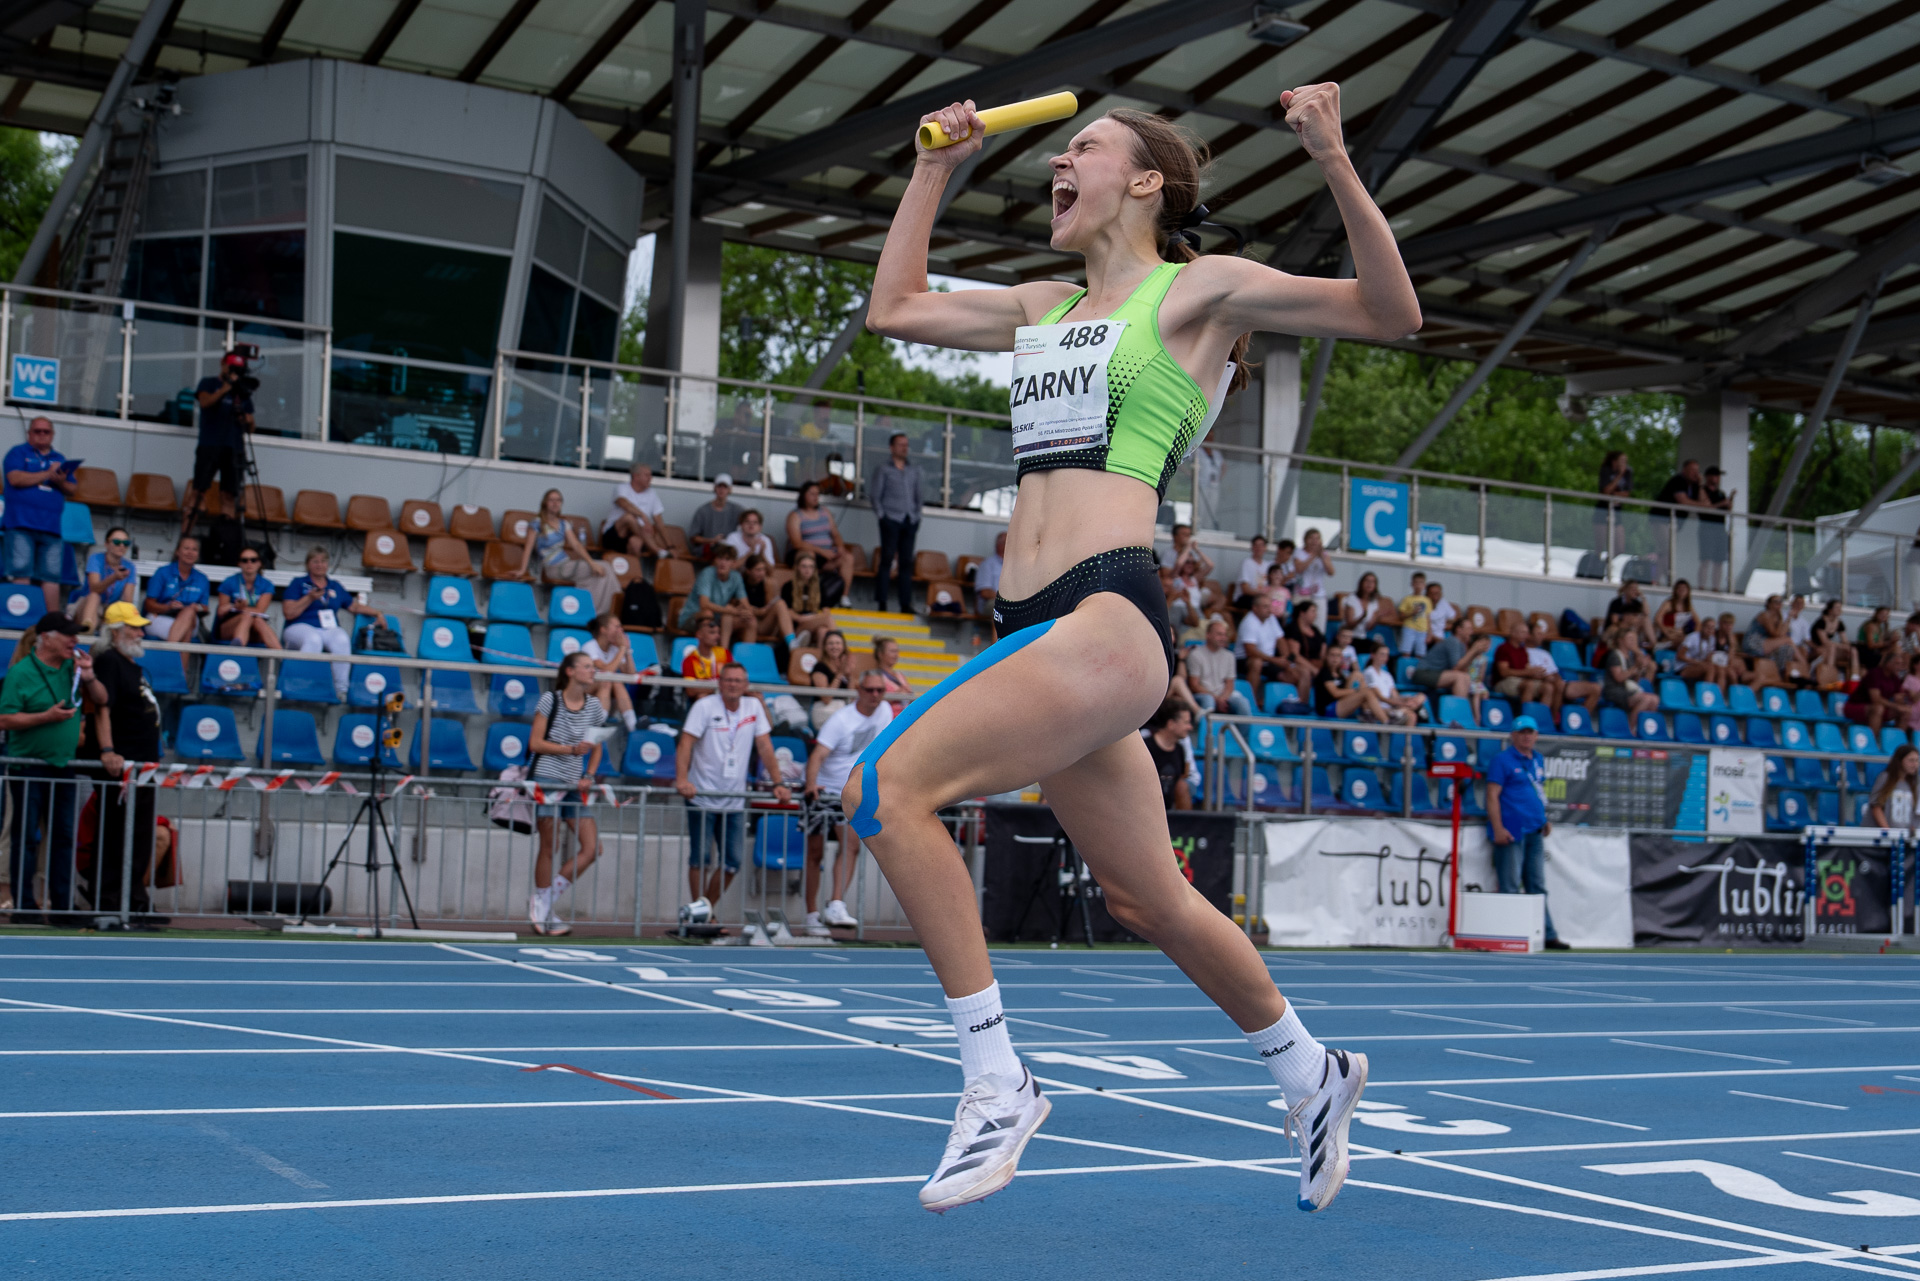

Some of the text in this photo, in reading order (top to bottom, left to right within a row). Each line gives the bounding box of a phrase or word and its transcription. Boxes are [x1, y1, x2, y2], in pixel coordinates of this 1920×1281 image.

[1059, 324, 1108, 350] 488
[16, 361, 55, 385] WC
[1011, 363, 1097, 409] ZARNY
[1361, 485, 1398, 499] SEKTOR
[1363, 500, 1395, 548] C
[1421, 528, 1443, 545] WC
[1543, 756, 1591, 780] unner
[1319, 846, 1482, 906] Lubl
[1375, 916, 1437, 930] MIASTO
[1718, 922, 1774, 937] MIASTO
[1259, 1040, 1296, 1058] didas
